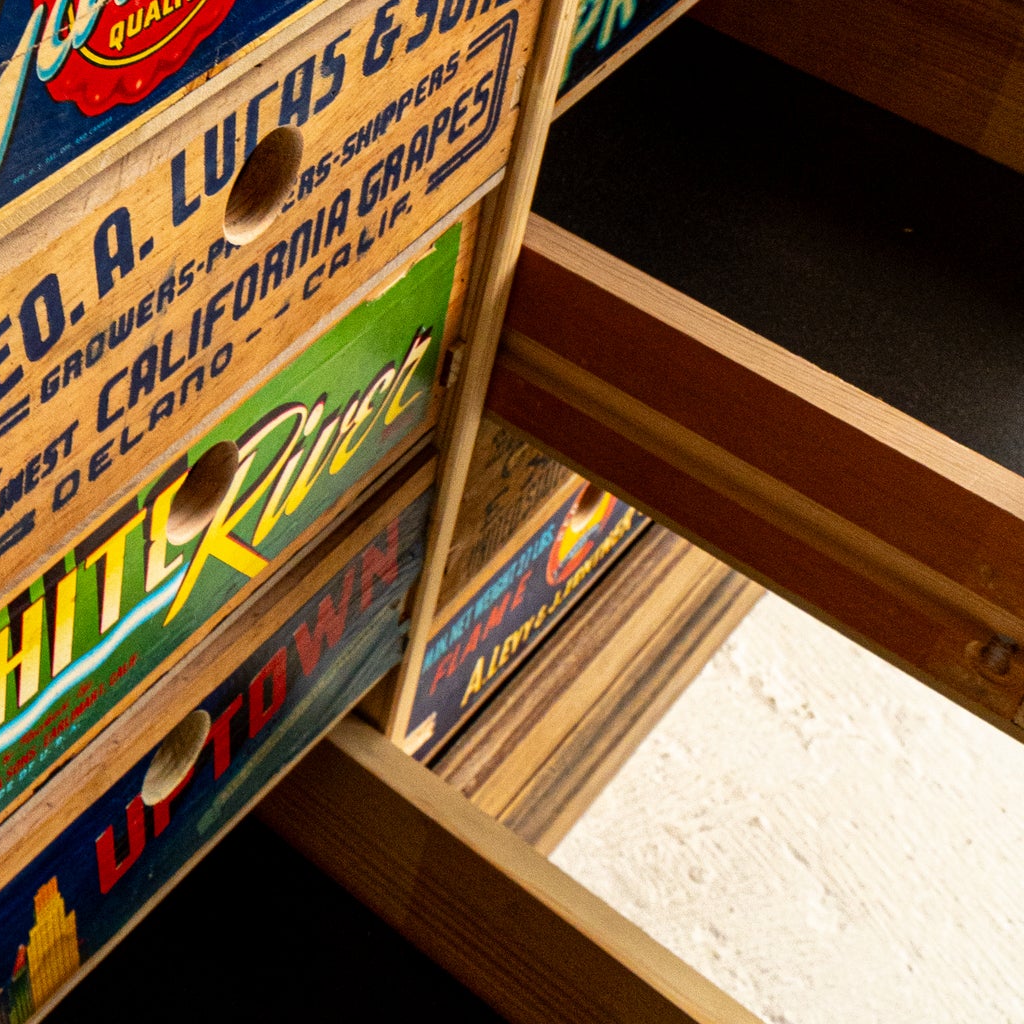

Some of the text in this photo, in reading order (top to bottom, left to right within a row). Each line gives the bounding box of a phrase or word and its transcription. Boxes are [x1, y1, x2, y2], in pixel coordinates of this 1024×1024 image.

[94, 206, 154, 300] A.
[171, 29, 351, 227] LUCAS
[97, 188, 352, 433] CALIFORNIA
[357, 70, 494, 217] GRAPES
[52, 191, 413, 513] DELANO CALIF.
[162, 328, 424, 628] River
[19, 761, 36, 779] OF
